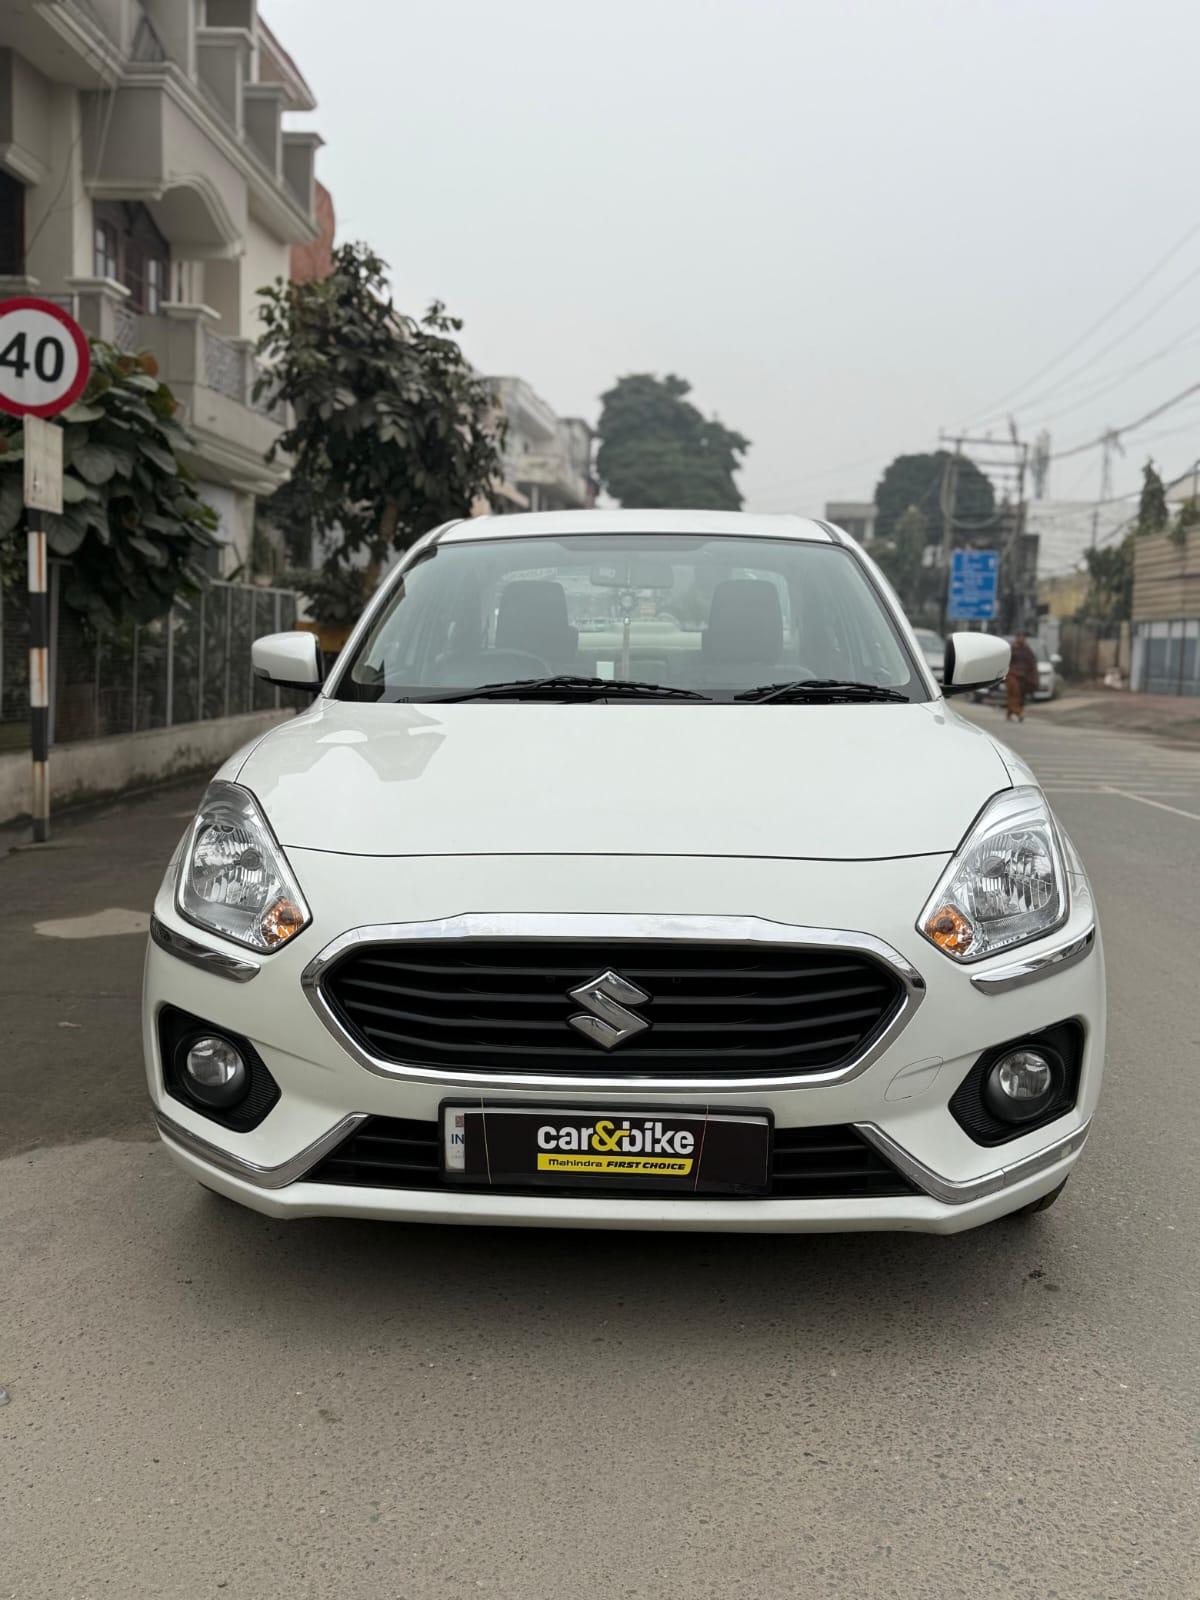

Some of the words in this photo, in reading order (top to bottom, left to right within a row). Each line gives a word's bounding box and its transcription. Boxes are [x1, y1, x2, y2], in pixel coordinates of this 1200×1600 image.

[0, 332, 64, 383] 40
[537, 1120, 695, 1154] car&bike
[548, 1159, 602, 1168] Mahindra
[606, 1161, 641, 1169] FIRST
[642, 1162, 686, 1171] CHOICE
